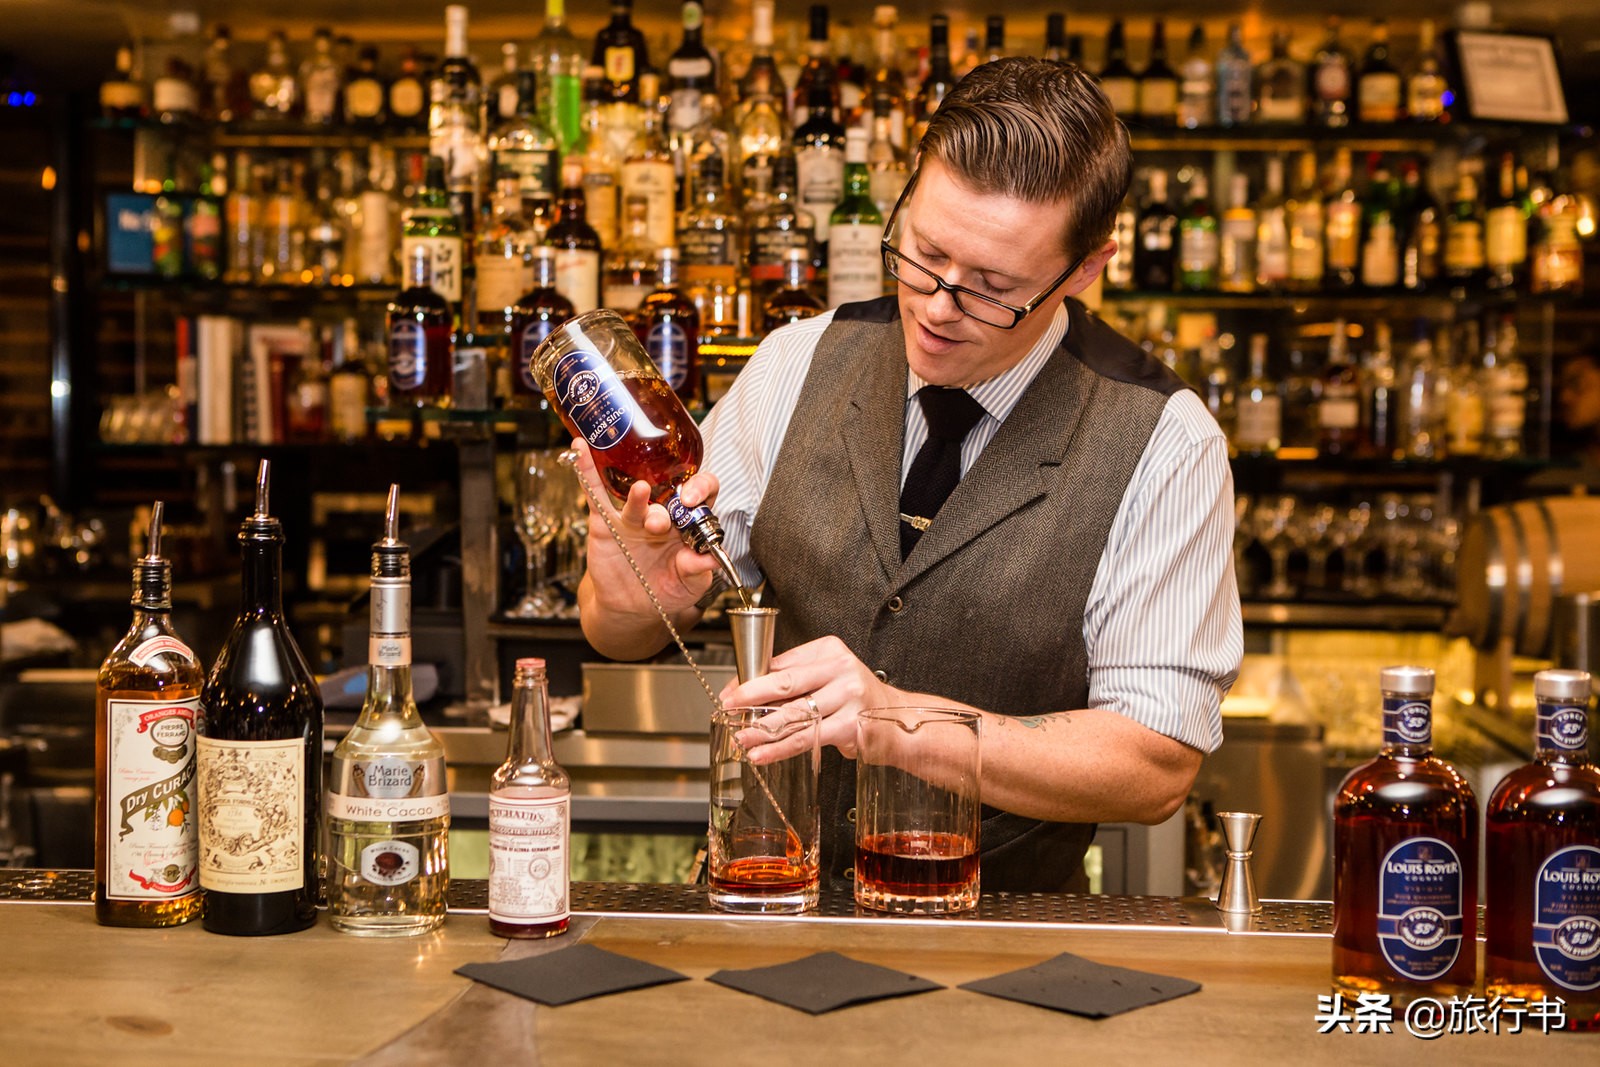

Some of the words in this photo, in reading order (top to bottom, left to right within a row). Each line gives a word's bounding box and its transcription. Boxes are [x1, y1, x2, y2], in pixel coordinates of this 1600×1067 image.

[579, 386, 596, 402] FORCE
[606, 406, 626, 424] OUIS
[589, 422, 608, 443] ROYER
[1403, 707, 1428, 716] FORCE
[1558, 713, 1583, 722] FORCE
[160, 723, 184, 731] PIERRE
[372, 765, 409, 777] Marie
[368, 775, 412, 786] Brizard
[126, 791, 149, 814] Dry
[346, 804, 382, 817] White
[387, 806, 433, 817] Cacao
[1387, 861, 1423, 875] LOUIS
[1424, 861, 1458, 875] ROYER
[1544, 869, 1580, 884] LOUIS
[1408, 911, 1439, 922] FORCE
[1566, 920, 1596, 932] FORCE
